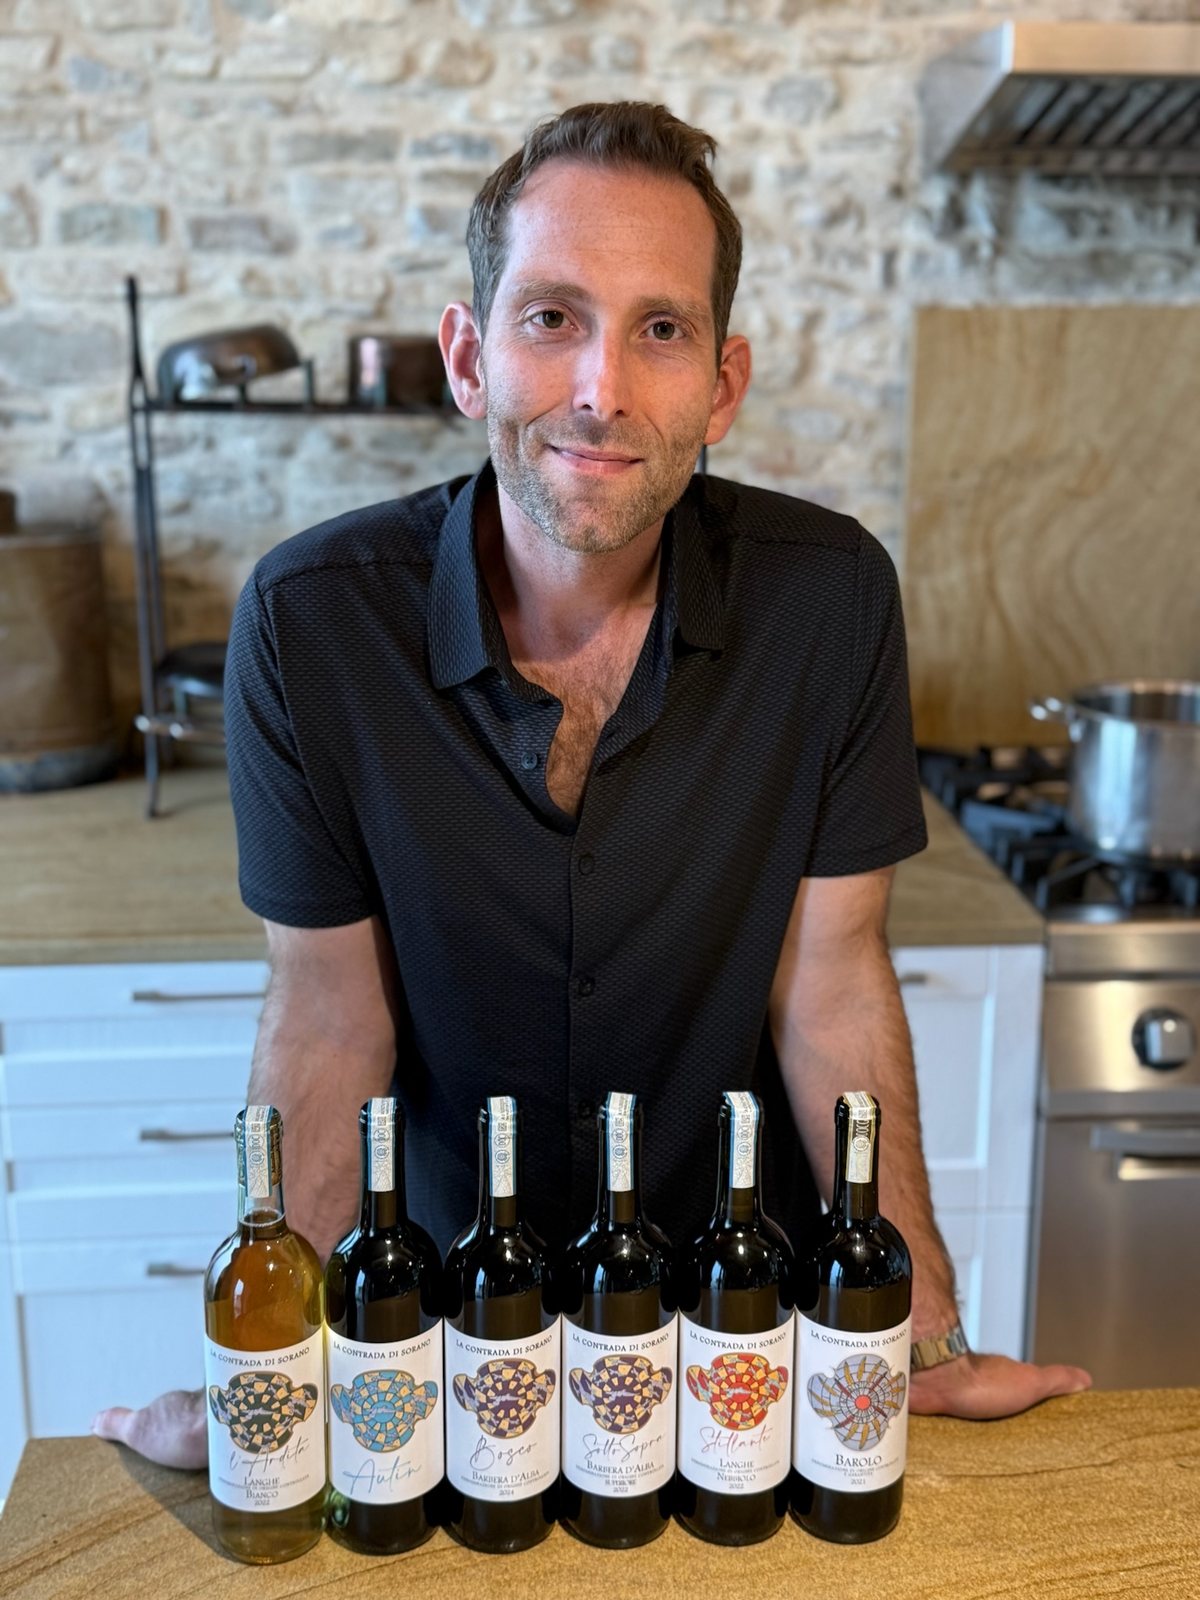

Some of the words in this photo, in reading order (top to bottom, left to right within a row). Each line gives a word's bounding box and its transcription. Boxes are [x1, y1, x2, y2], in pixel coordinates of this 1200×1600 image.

[456, 1339, 464, 1349] LA
[465, 1343, 510, 1356] CONTRADA
[525, 1334, 553, 1353] SORANO
[572, 1333, 580, 1343] LA
[582, 1339, 626, 1352] CONTRADA
[629, 1343, 639, 1351] DI
[641, 1332, 669, 1350] SORANO
[689, 1330, 698, 1340] LA
[699, 1336, 745, 1350] CONTRADA
[759, 1331, 787, 1348] SORANO
[810, 1329, 820, 1340] LA
[821, 1335, 868, 1348] CONTRADA
[210, 1348, 217, 1357] LA
[218, 1354, 262, 1367] CONTRADA
[265, 1359, 275, 1367] DI
[278, 1346, 310, 1364] SORANO
[333, 1341, 341, 1350] LA
[342, 1347, 385, 1359] CONTRADA
[401, 1338, 431, 1356] SORANO
[469, 1434, 537, 1471] Bosco
[835, 1454, 882, 1467] BAROLO
[587, 1460, 623, 1474] BARBERA
[626, 1461, 654, 1474] D'ALBA
[719, 1458, 754, 1468] LANGHE
[244, 1476, 280, 1486] LANGHE
[472, 1471, 509, 1483] BARBERA
[511, 1469, 540, 1483] D'ALBA
[717, 1472, 756, 1481] NEBBIOLO
[246, 1490, 279, 1498] BIANCO
